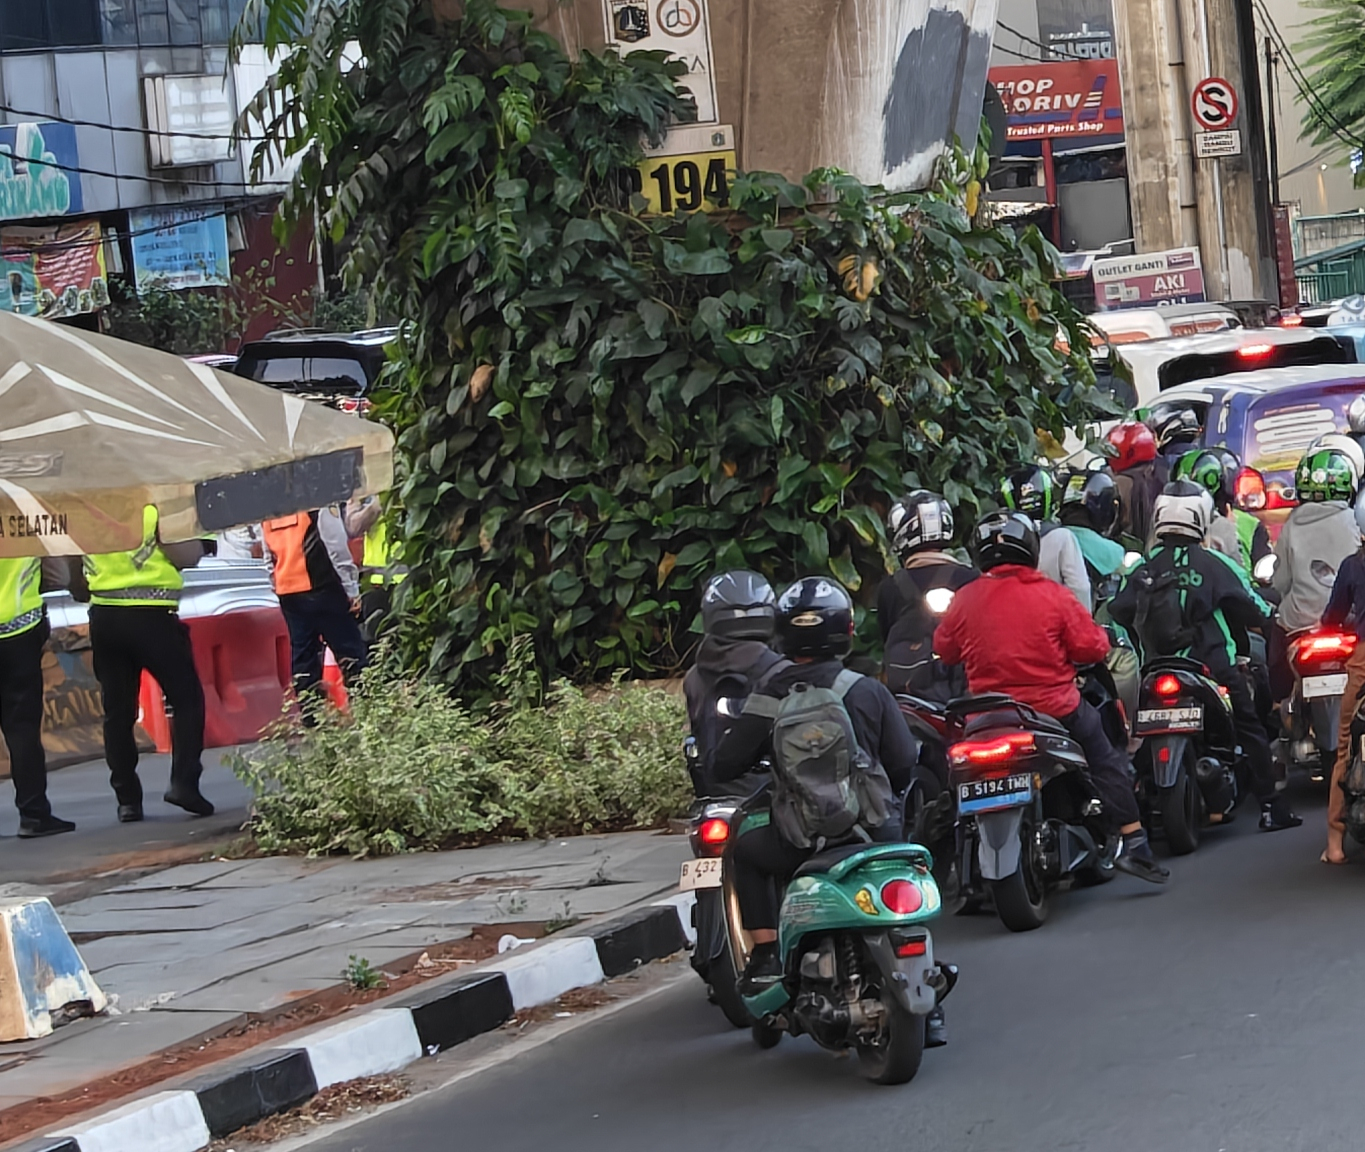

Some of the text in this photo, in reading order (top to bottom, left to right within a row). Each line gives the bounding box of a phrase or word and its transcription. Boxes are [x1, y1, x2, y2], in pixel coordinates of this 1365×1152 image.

[995, 78, 1053, 96] HOP
[1006, 124, 1046, 136] Trusted
[1078, 121, 1104, 132] Shop
[650, 158, 730, 212] 194
[1098, 260, 1163, 276] OUTLET GANTI
[1154, 274, 1185, 292] AKI
[9, 513, 68, 537] SELATAN
[1178, 569, 1203, 587] ab
[961, 786, 969, 799] B
